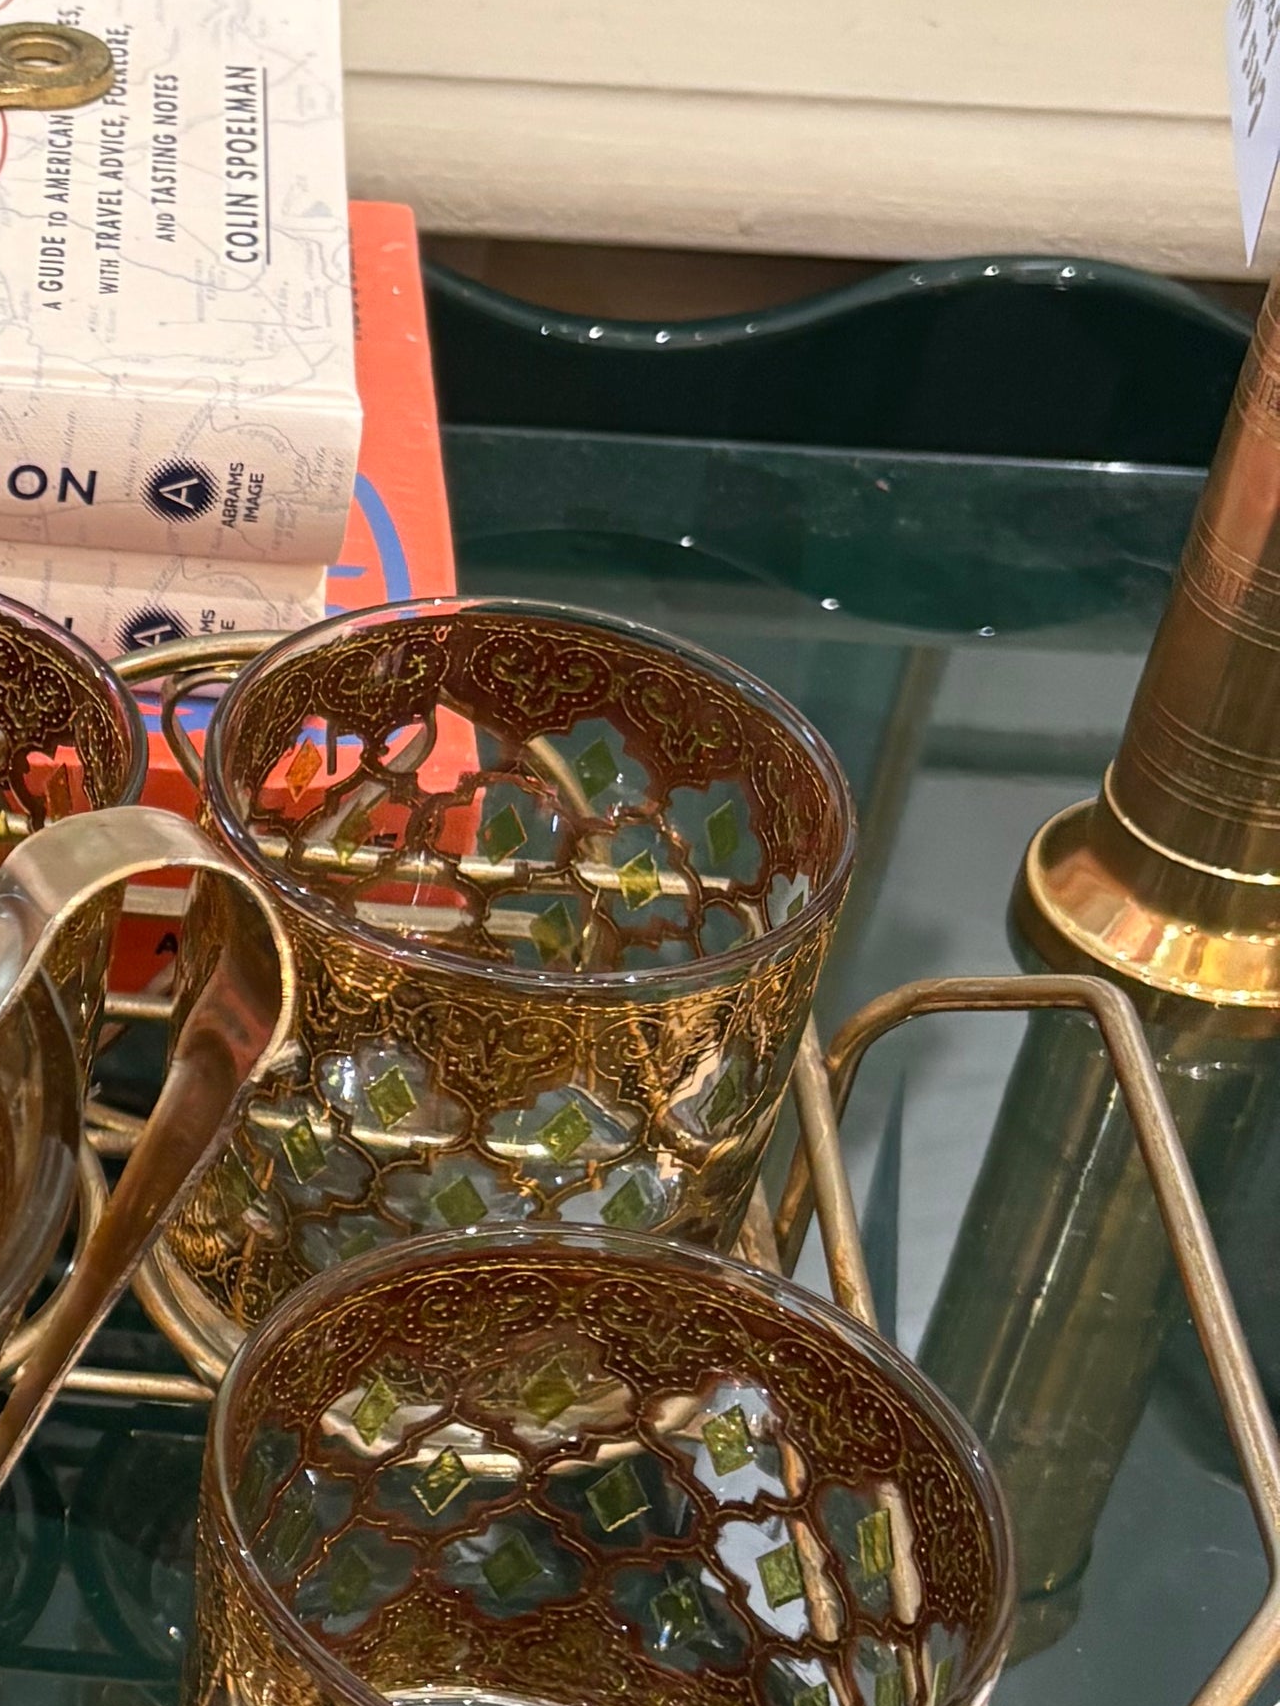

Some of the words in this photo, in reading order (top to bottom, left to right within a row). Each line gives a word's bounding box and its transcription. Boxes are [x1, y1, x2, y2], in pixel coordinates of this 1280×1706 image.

[153, 73, 179, 126] NOTES
[225, 64, 259, 182] SPOELMAN
[44, 113, 75, 204] AMERICAN
[99, 114, 131, 182] ADVICE,
[151, 134, 178, 206] TASTING
[48, 211, 68, 228] TO
[95, 188, 123, 252] TRAVEL
[155, 211, 176, 243] AND
[225, 192, 259, 264] COLIN
[38, 235, 67, 293] GUIDE
[99, 257, 121, 295] WITH
[42, 300, 62, 311] A
[220, 461, 245, 529] ABRAMS
[242, 472, 265, 524] IMAGE
